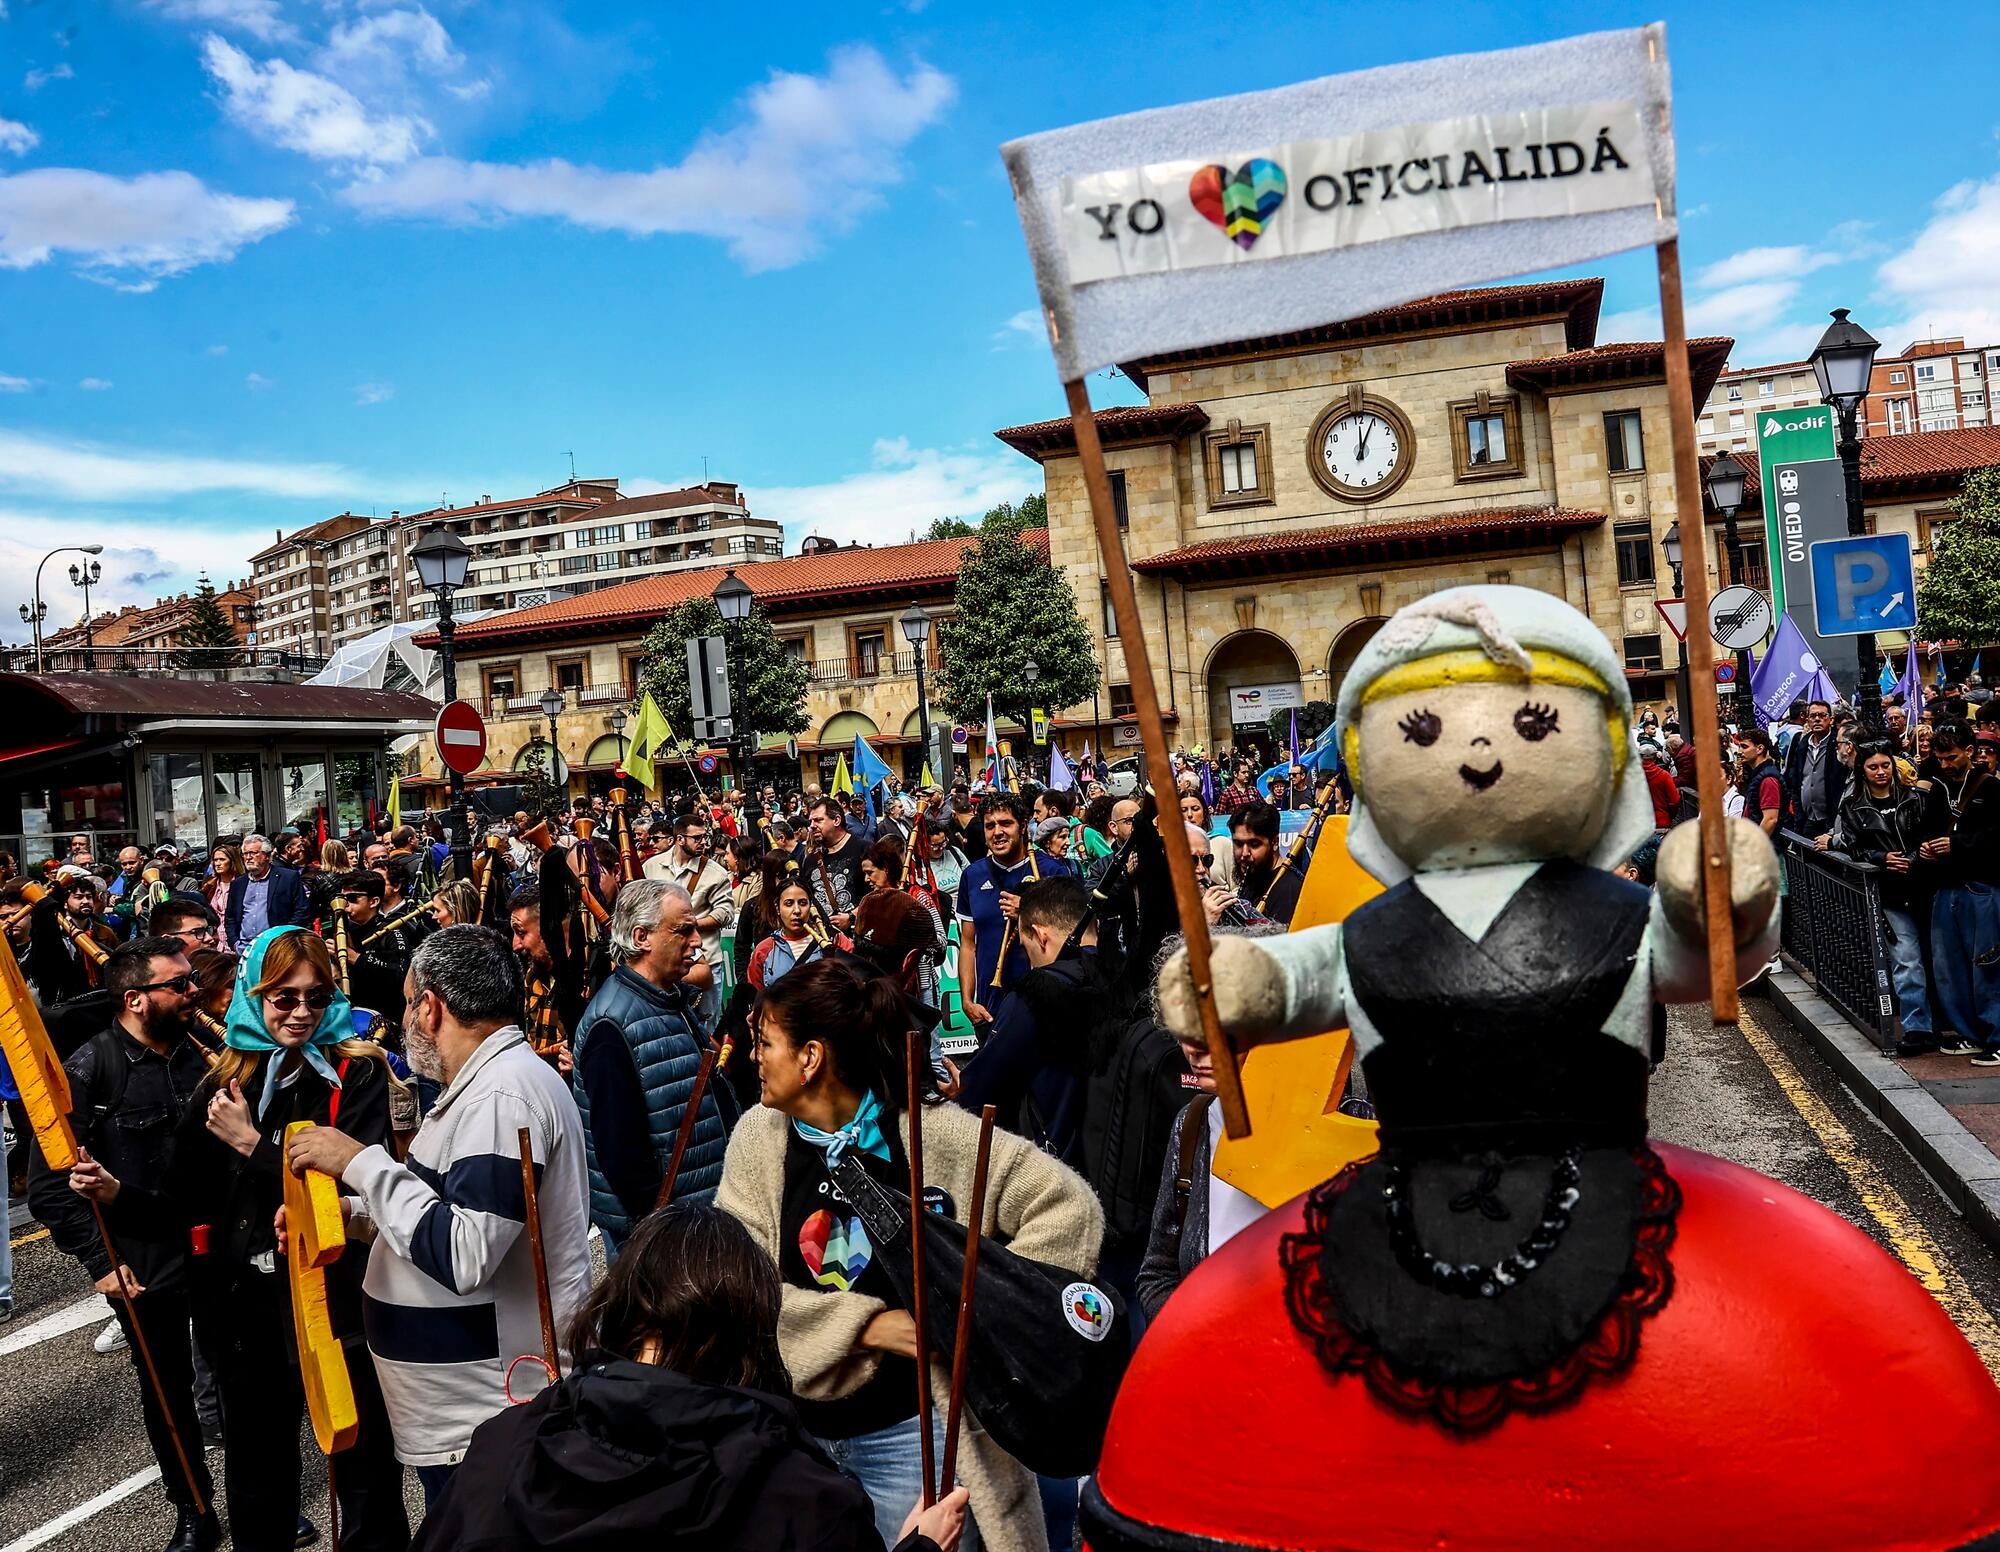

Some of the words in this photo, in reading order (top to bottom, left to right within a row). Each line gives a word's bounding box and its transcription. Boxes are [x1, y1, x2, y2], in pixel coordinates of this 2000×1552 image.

[1085, 199, 1165, 240] YO
[1304, 127, 1628, 211] OFICIALIDÁ
[1354, 415, 1364, 425] 12
[1785, 415, 1827, 432] adif
[1341, 421, 1347, 430] 11
[1385, 427, 1390, 435] 2
[1329, 434, 1338, 443] 10
[1391, 443, 1397, 451] 3
[1326, 450, 1332, 458] 9
[1387, 459, 1393, 467] 4
[1331, 465, 1338, 473] 8
[1344, 474, 1349, 482] 7
[1377, 471, 1384, 480] 5
[1361, 478, 1367, 486] 6
[1784, 502, 1805, 562] OVIEDO
[1834, 550, 1889, 620] P
[1181, 1074, 1199, 1084] BAGP
[1066, 1285, 1093, 1314] OFICIALIDÁ
